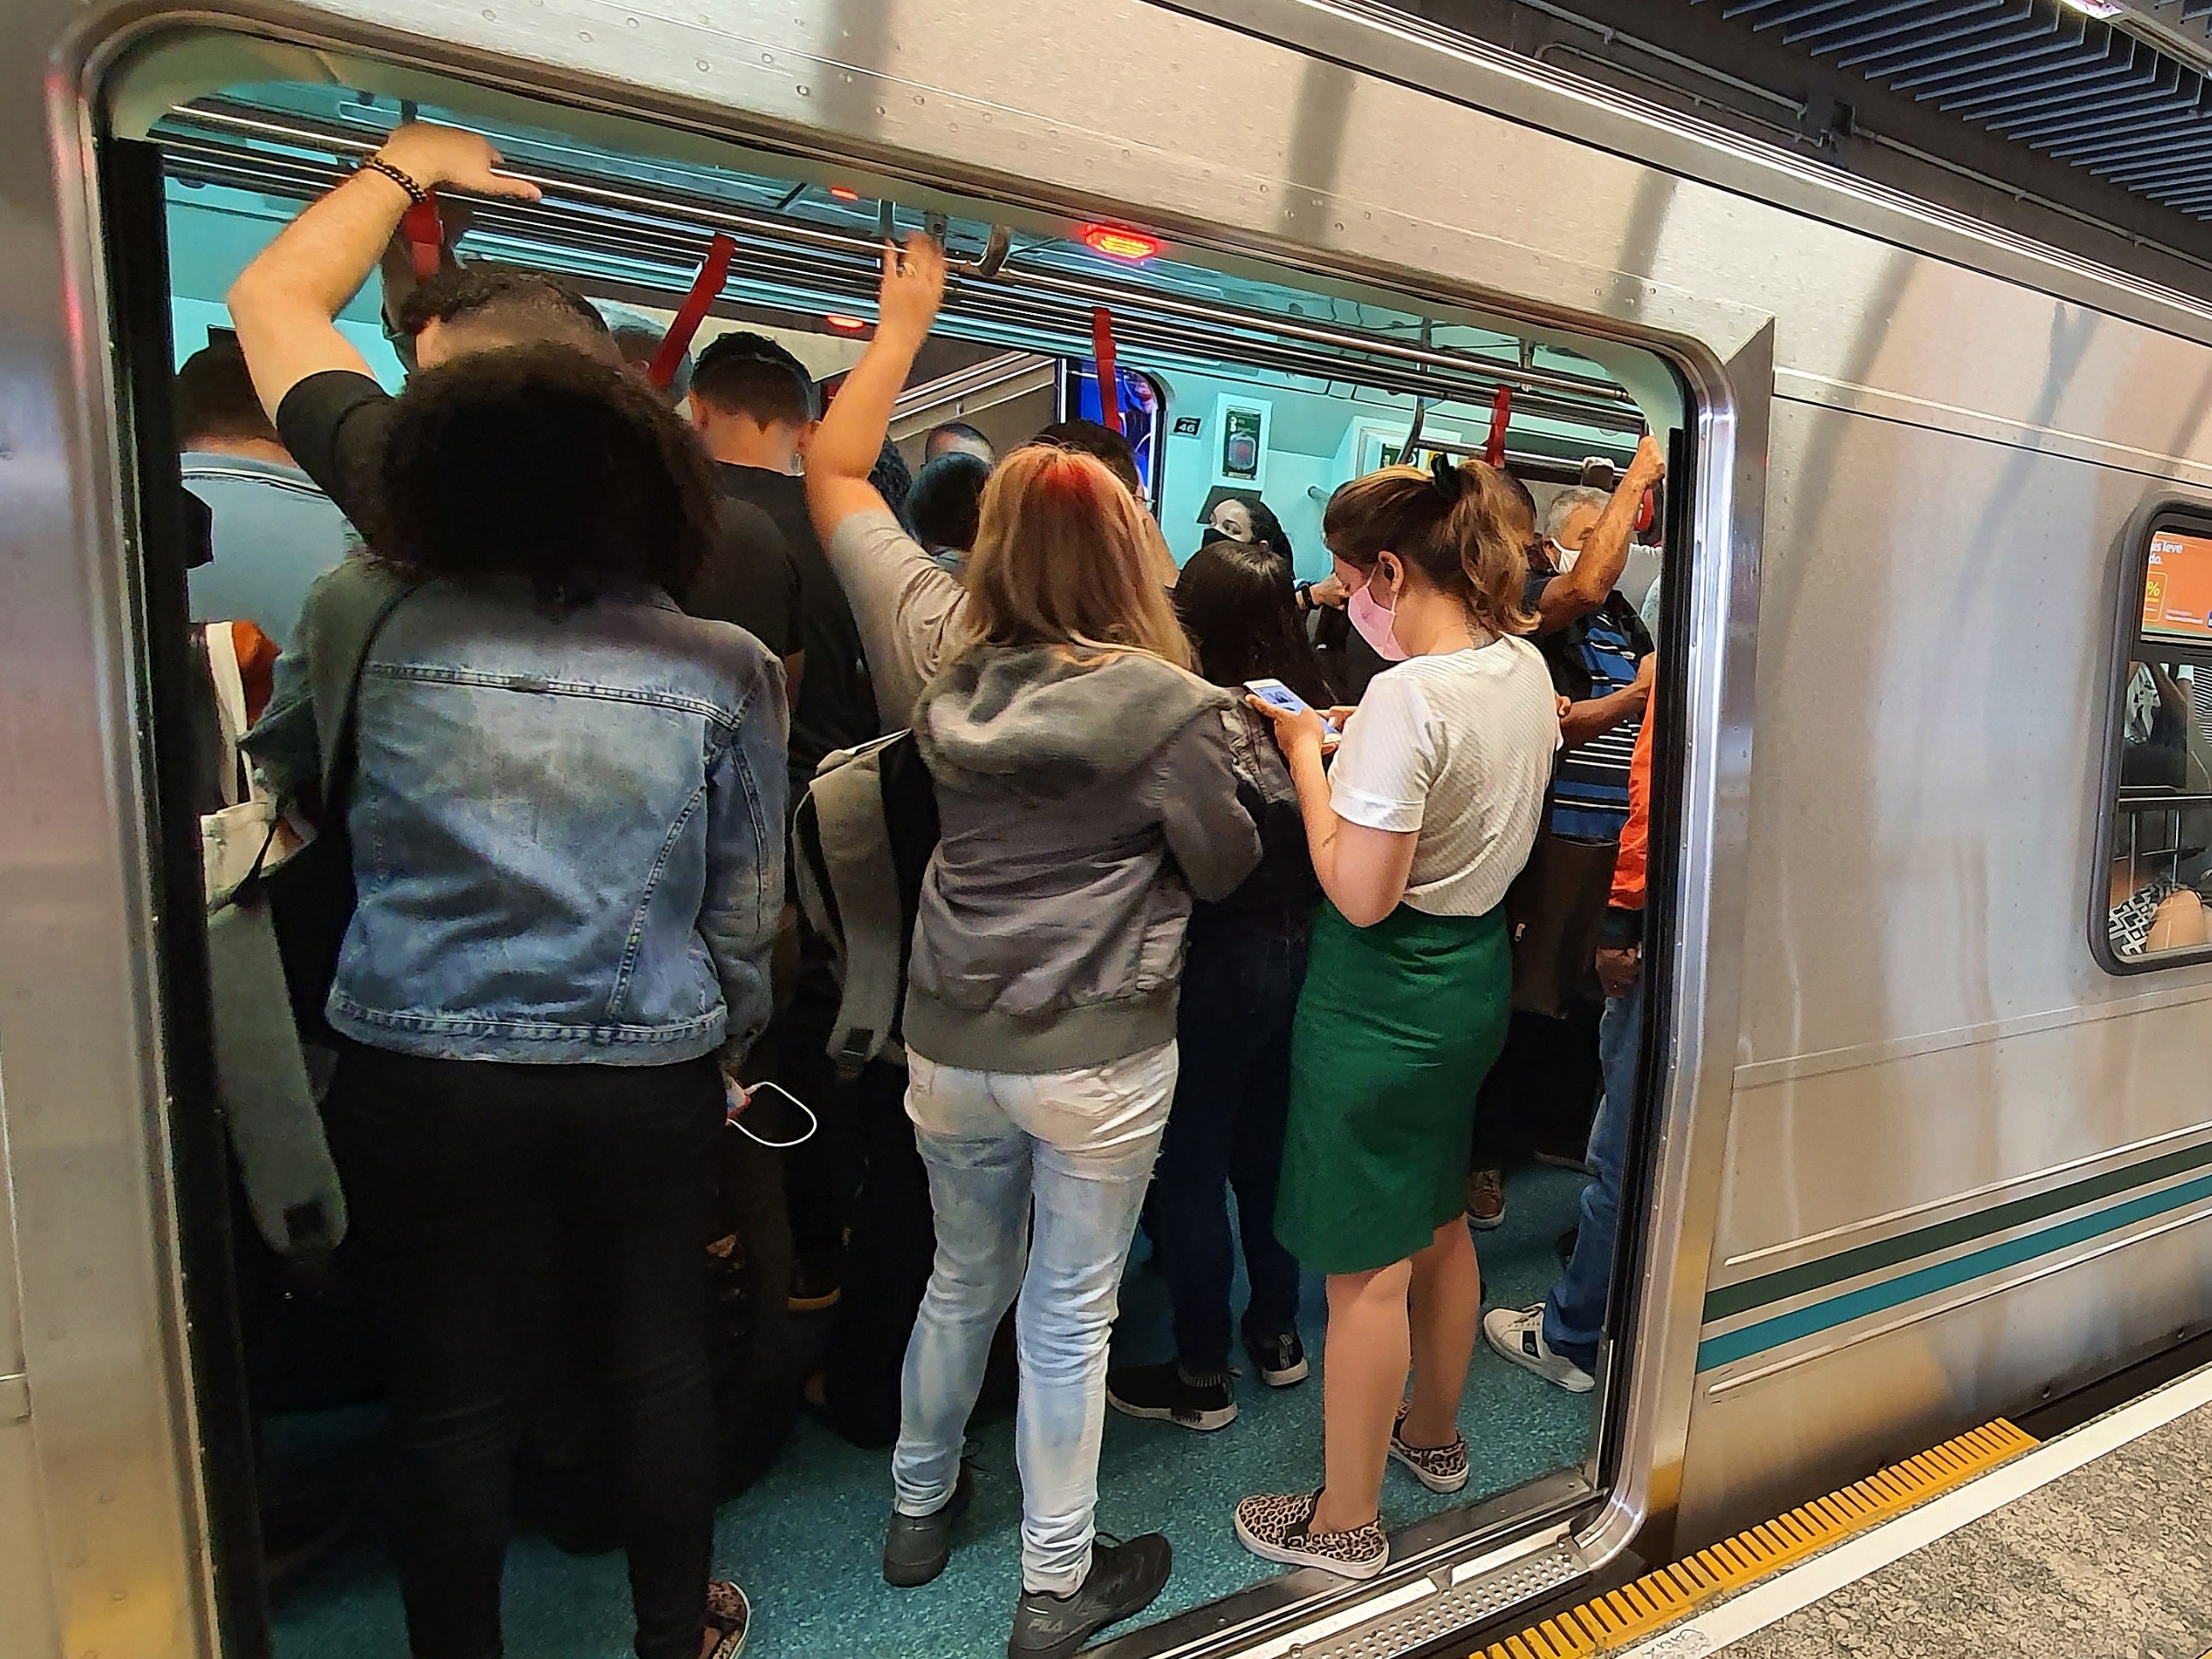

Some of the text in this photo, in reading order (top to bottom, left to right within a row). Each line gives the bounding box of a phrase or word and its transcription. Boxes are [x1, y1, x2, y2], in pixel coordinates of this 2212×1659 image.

[1178, 423, 1195, 433] 46
[2162, 541, 2183, 554] leve
[1028, 1618, 1063, 1632] FILA
